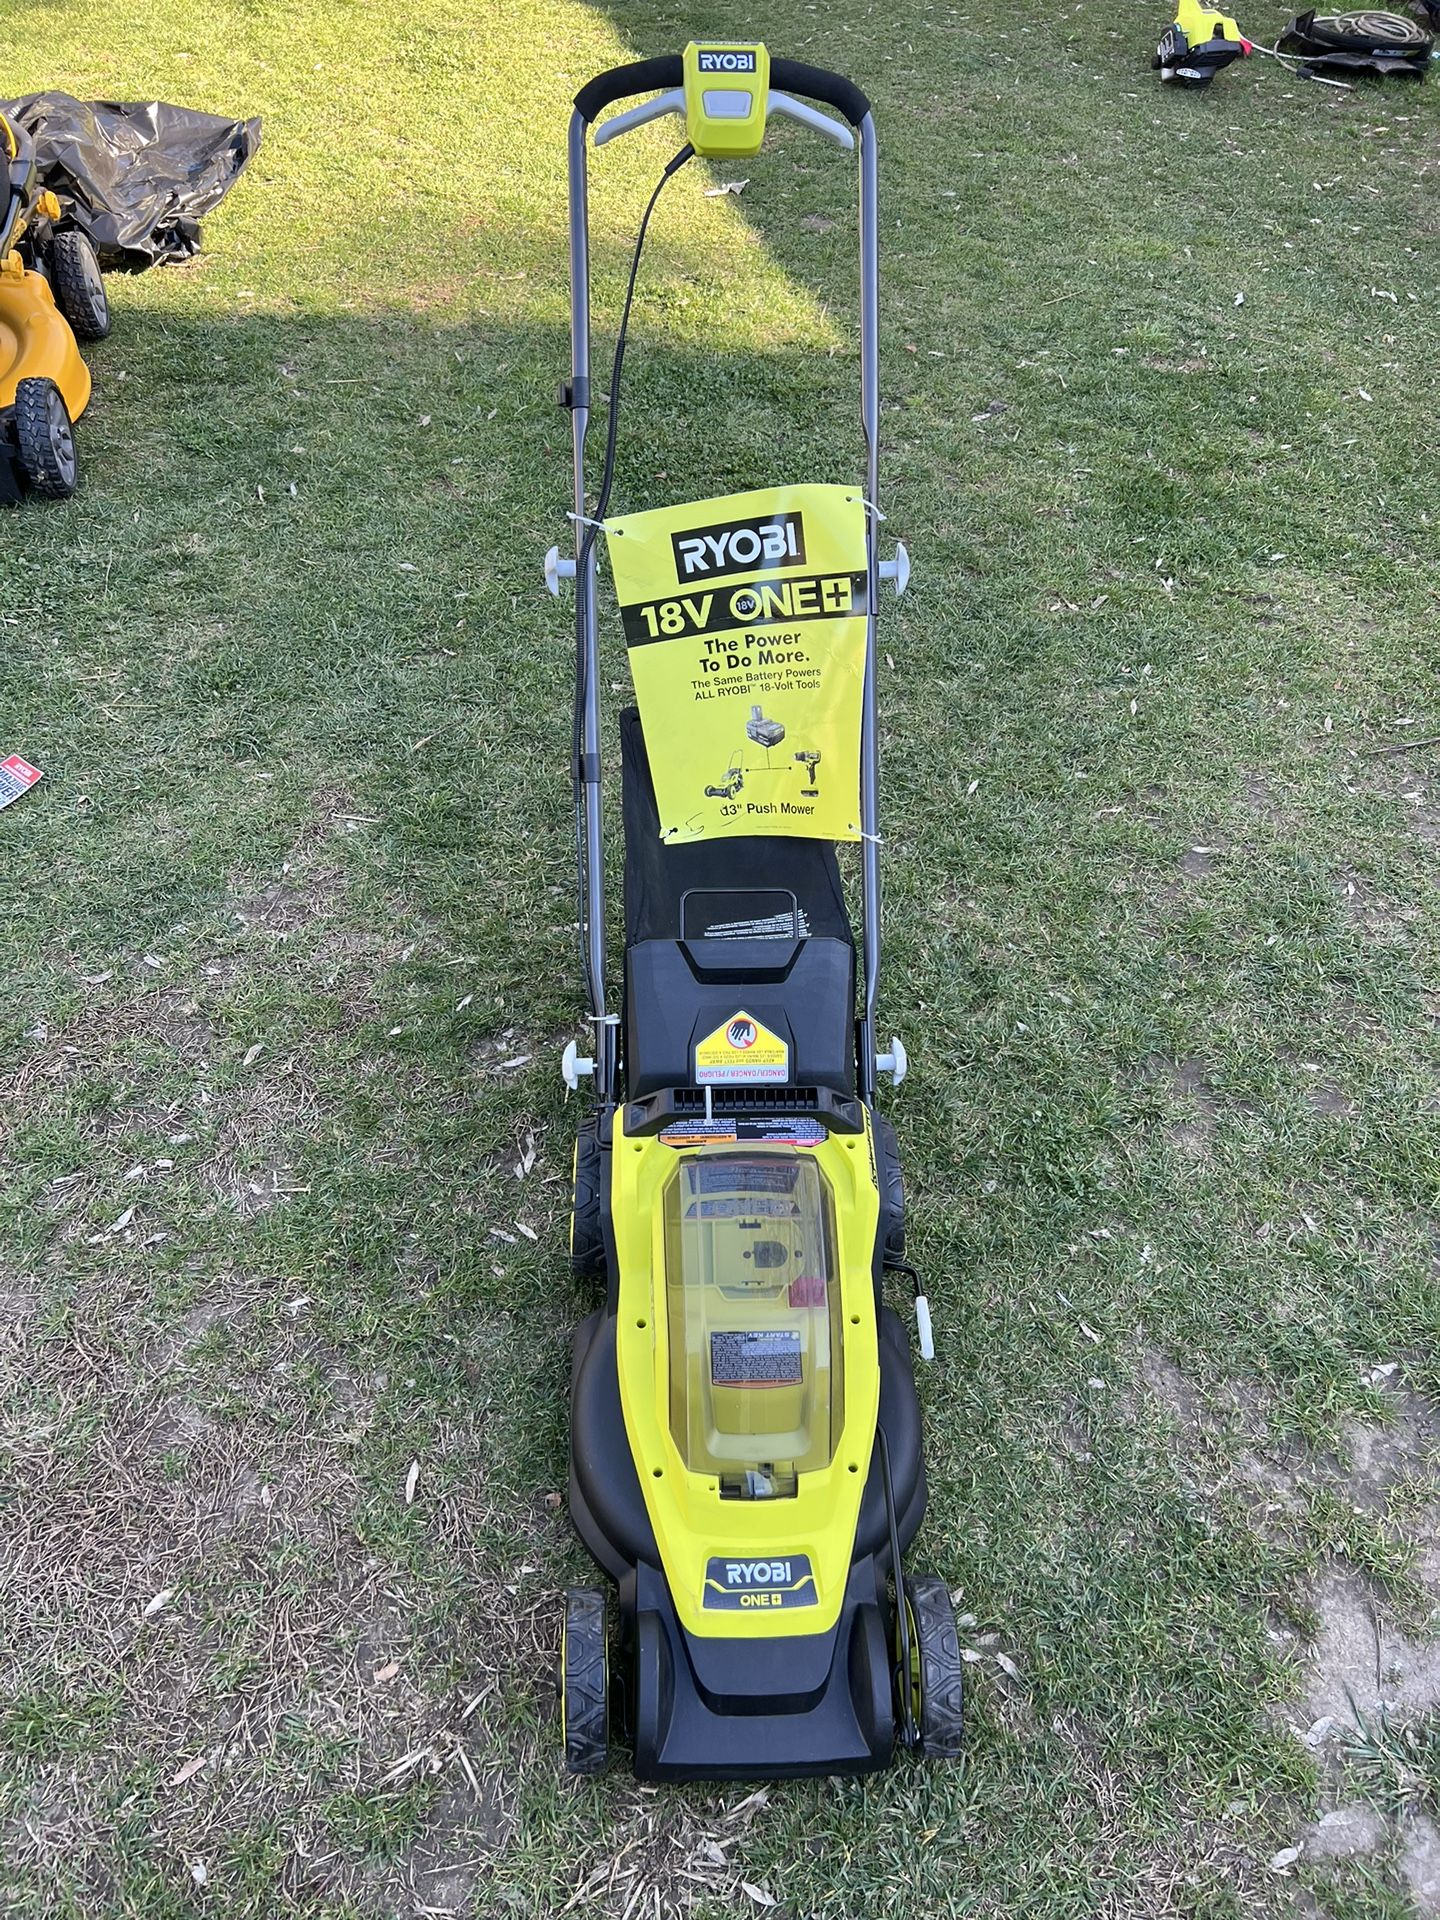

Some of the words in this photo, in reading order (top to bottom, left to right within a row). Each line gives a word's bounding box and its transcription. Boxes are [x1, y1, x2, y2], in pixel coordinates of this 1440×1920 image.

[700, 54, 753, 69] RYOBI
[678, 522, 798, 574] RYOBI
[640, 594, 714, 638] 18V
[736, 600, 755, 612] 18V
[704, 638, 738, 654] The
[745, 633, 801, 649] Power
[699, 658, 720, 673] To
[727, 654, 752, 669] Do
[758, 650, 810, 665] More.
[691, 680, 711, 689] The
[713, 675, 743, 686] Same
[745, 671, 783, 682] Battery
[786, 668, 821, 678] Powers
[695, 690, 715, 701] ALL
[760, 682, 794, 692] 18-Volt
[796, 679, 821, 689] Tools
[0, 767, 27, 793] MAZING
[747, 802, 778, 814] Push
[780, 802, 815, 815] Mower
[699, 1070, 726, 1078] PELIGRO
[725, 1562, 792, 1584] RYOBI
